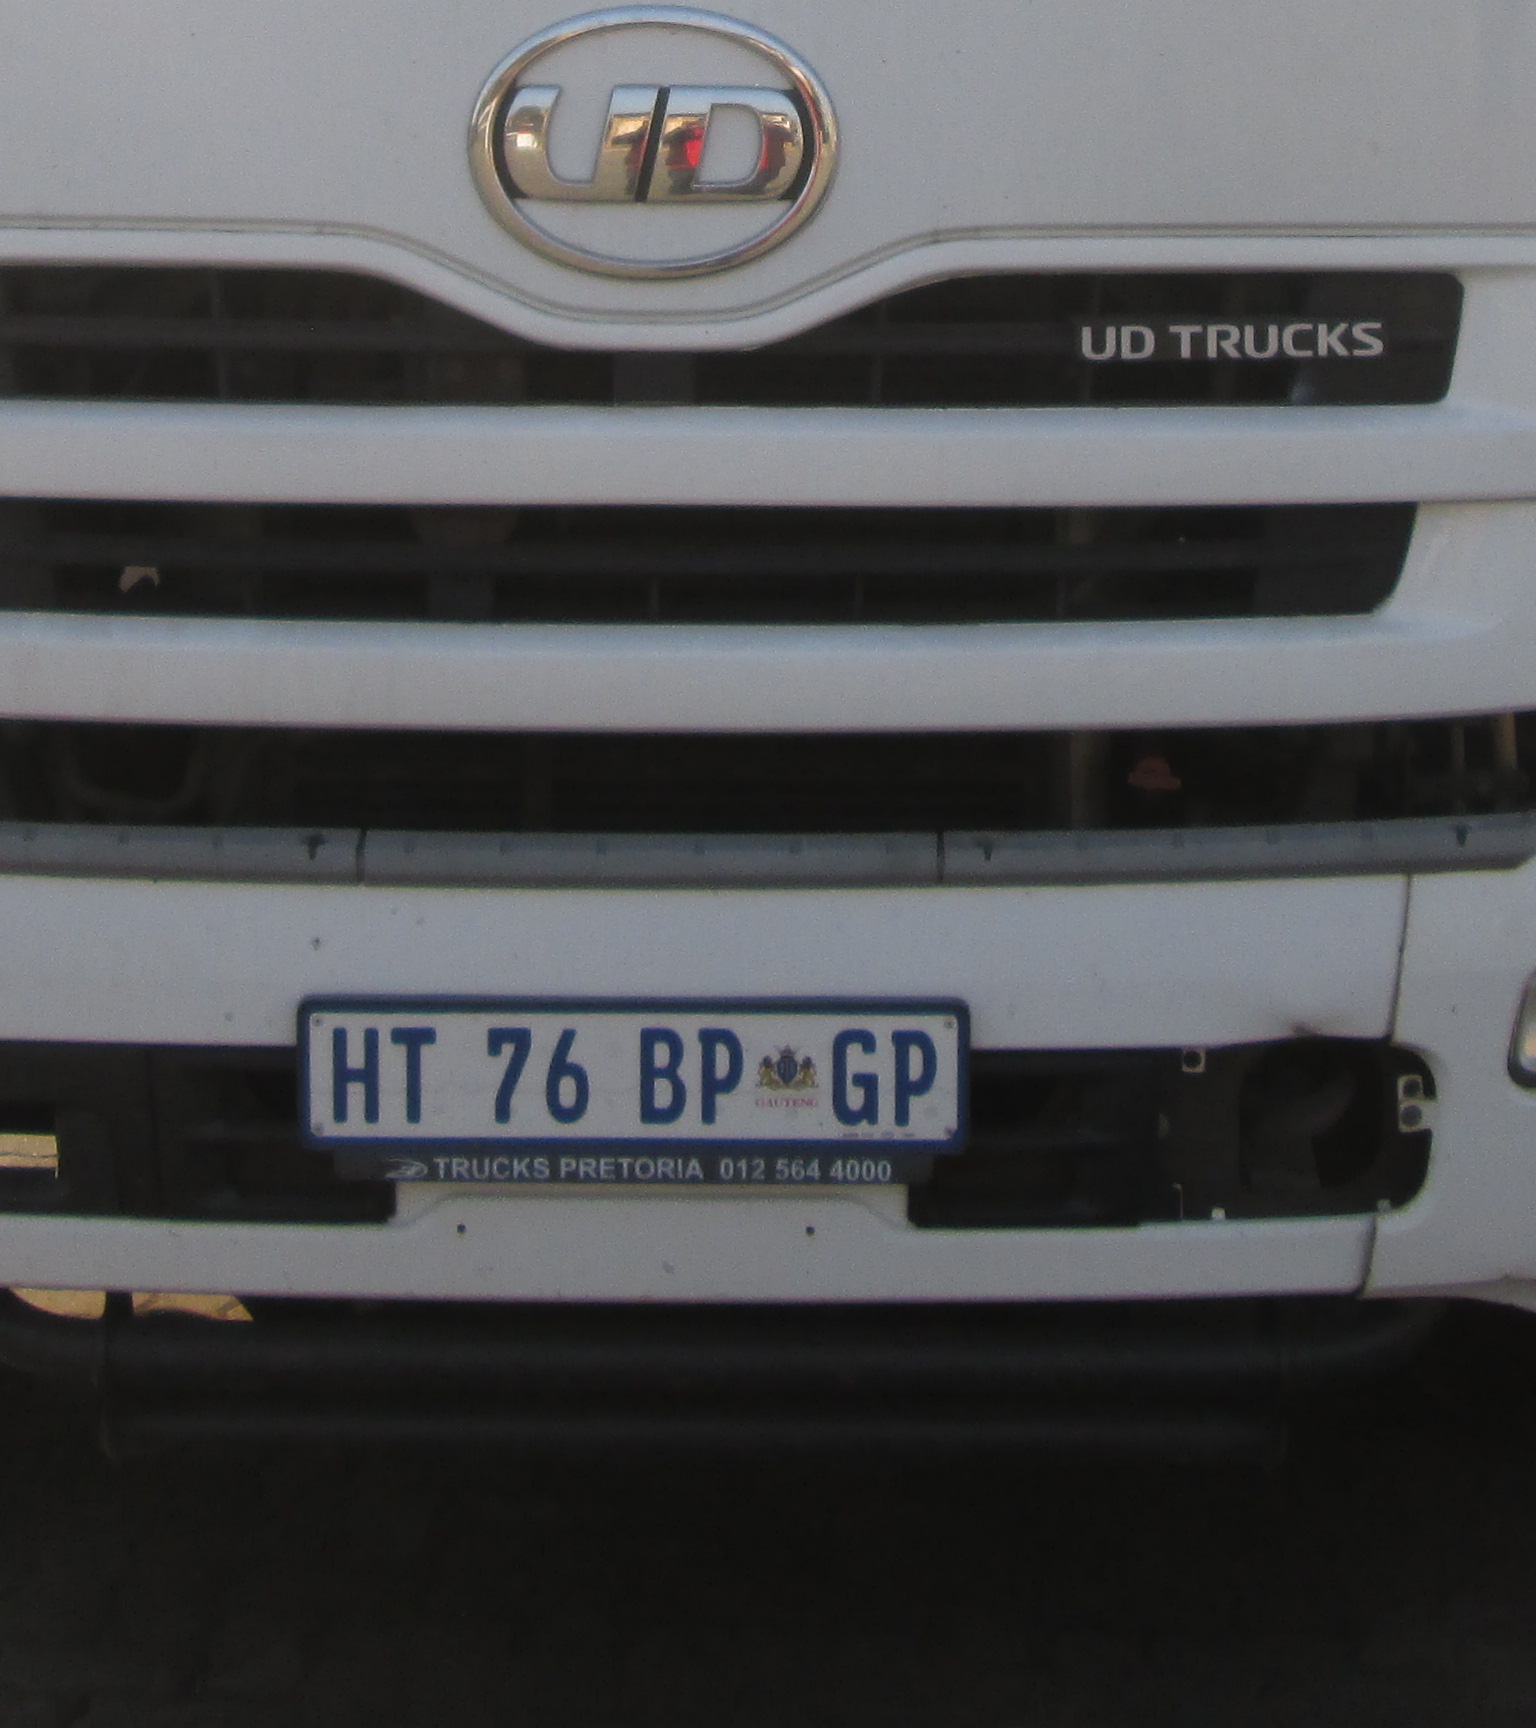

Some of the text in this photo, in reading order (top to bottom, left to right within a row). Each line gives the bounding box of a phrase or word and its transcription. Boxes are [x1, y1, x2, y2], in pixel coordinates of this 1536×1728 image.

[501, 84, 809, 203] UD
[1080, 322, 1385, 360] UD TRUCKS
[332, 1027, 938, 1127] HT 76 BP GP
[755, 1097, 819, 1108] GAUTENG
[432, 1157, 893, 1182] TRUCKS PRETORIA 012 564 4000
